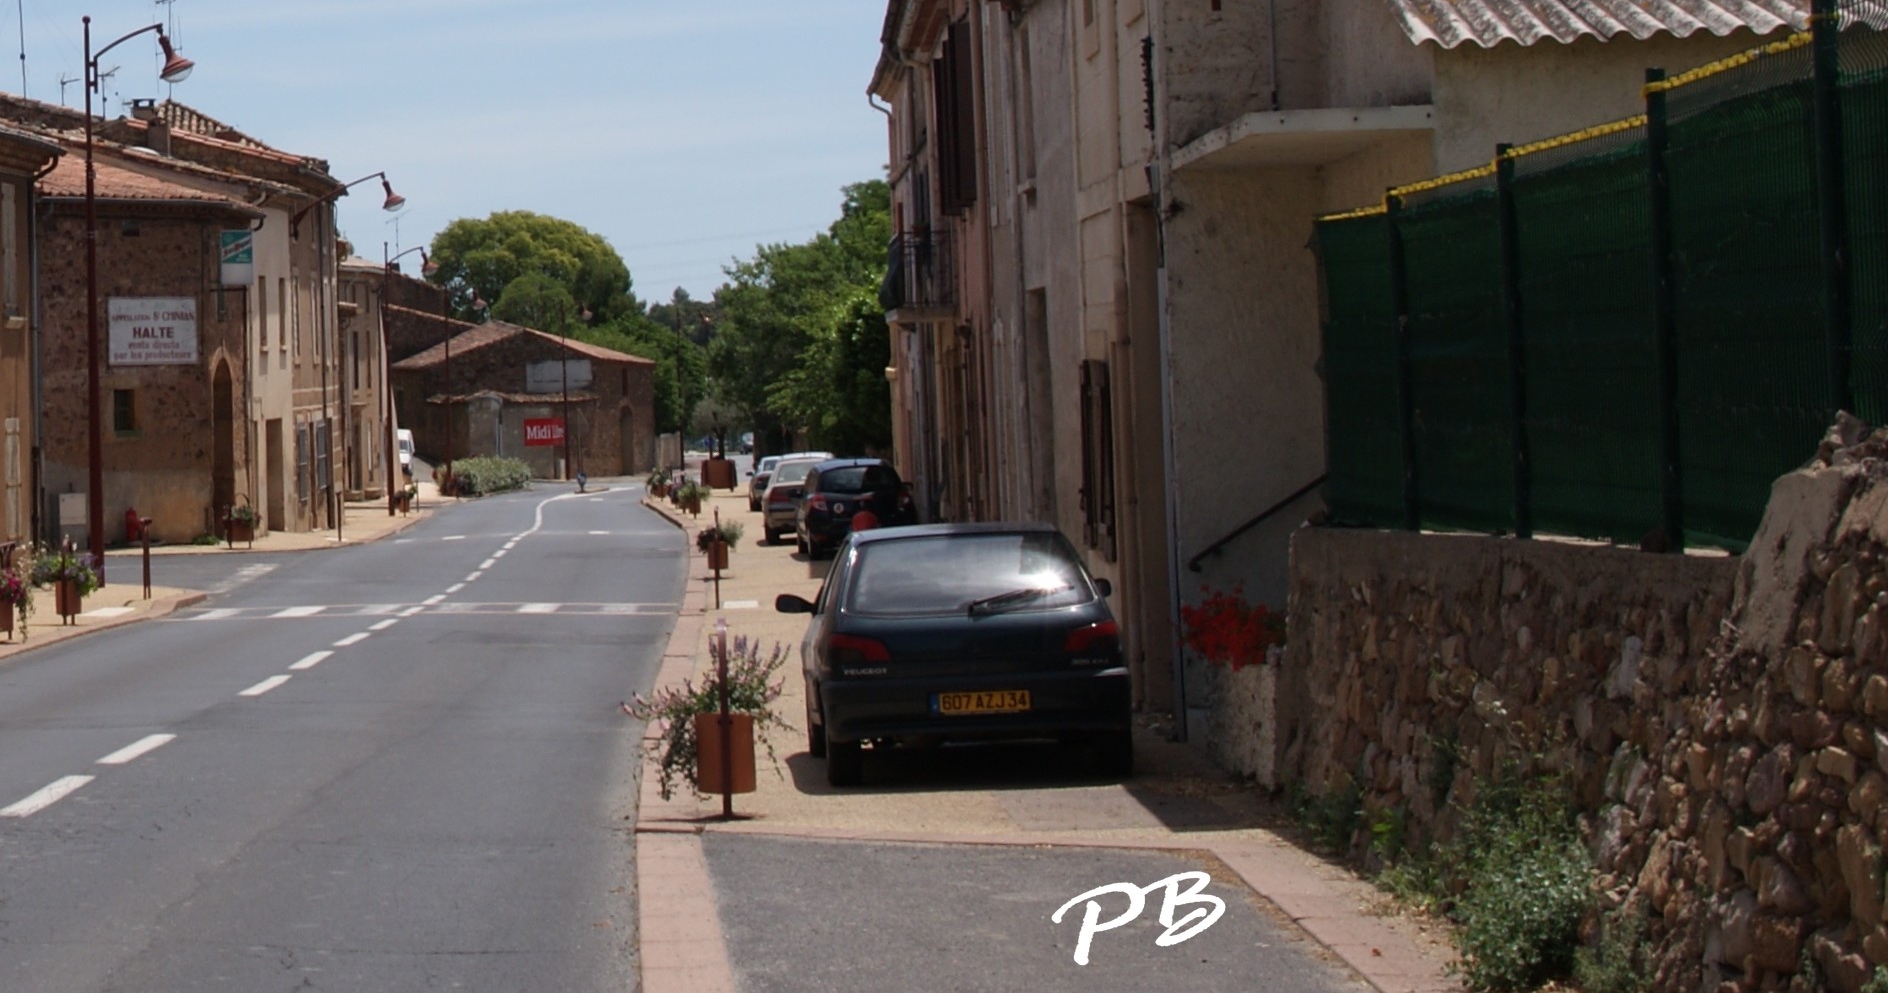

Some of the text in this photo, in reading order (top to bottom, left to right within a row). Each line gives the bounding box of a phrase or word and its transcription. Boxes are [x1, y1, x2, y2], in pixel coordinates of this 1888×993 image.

[133, 327, 174, 338] HALTE
[526, 425, 551, 440] Midi
[843, 667, 888, 675] PEUGEOT
